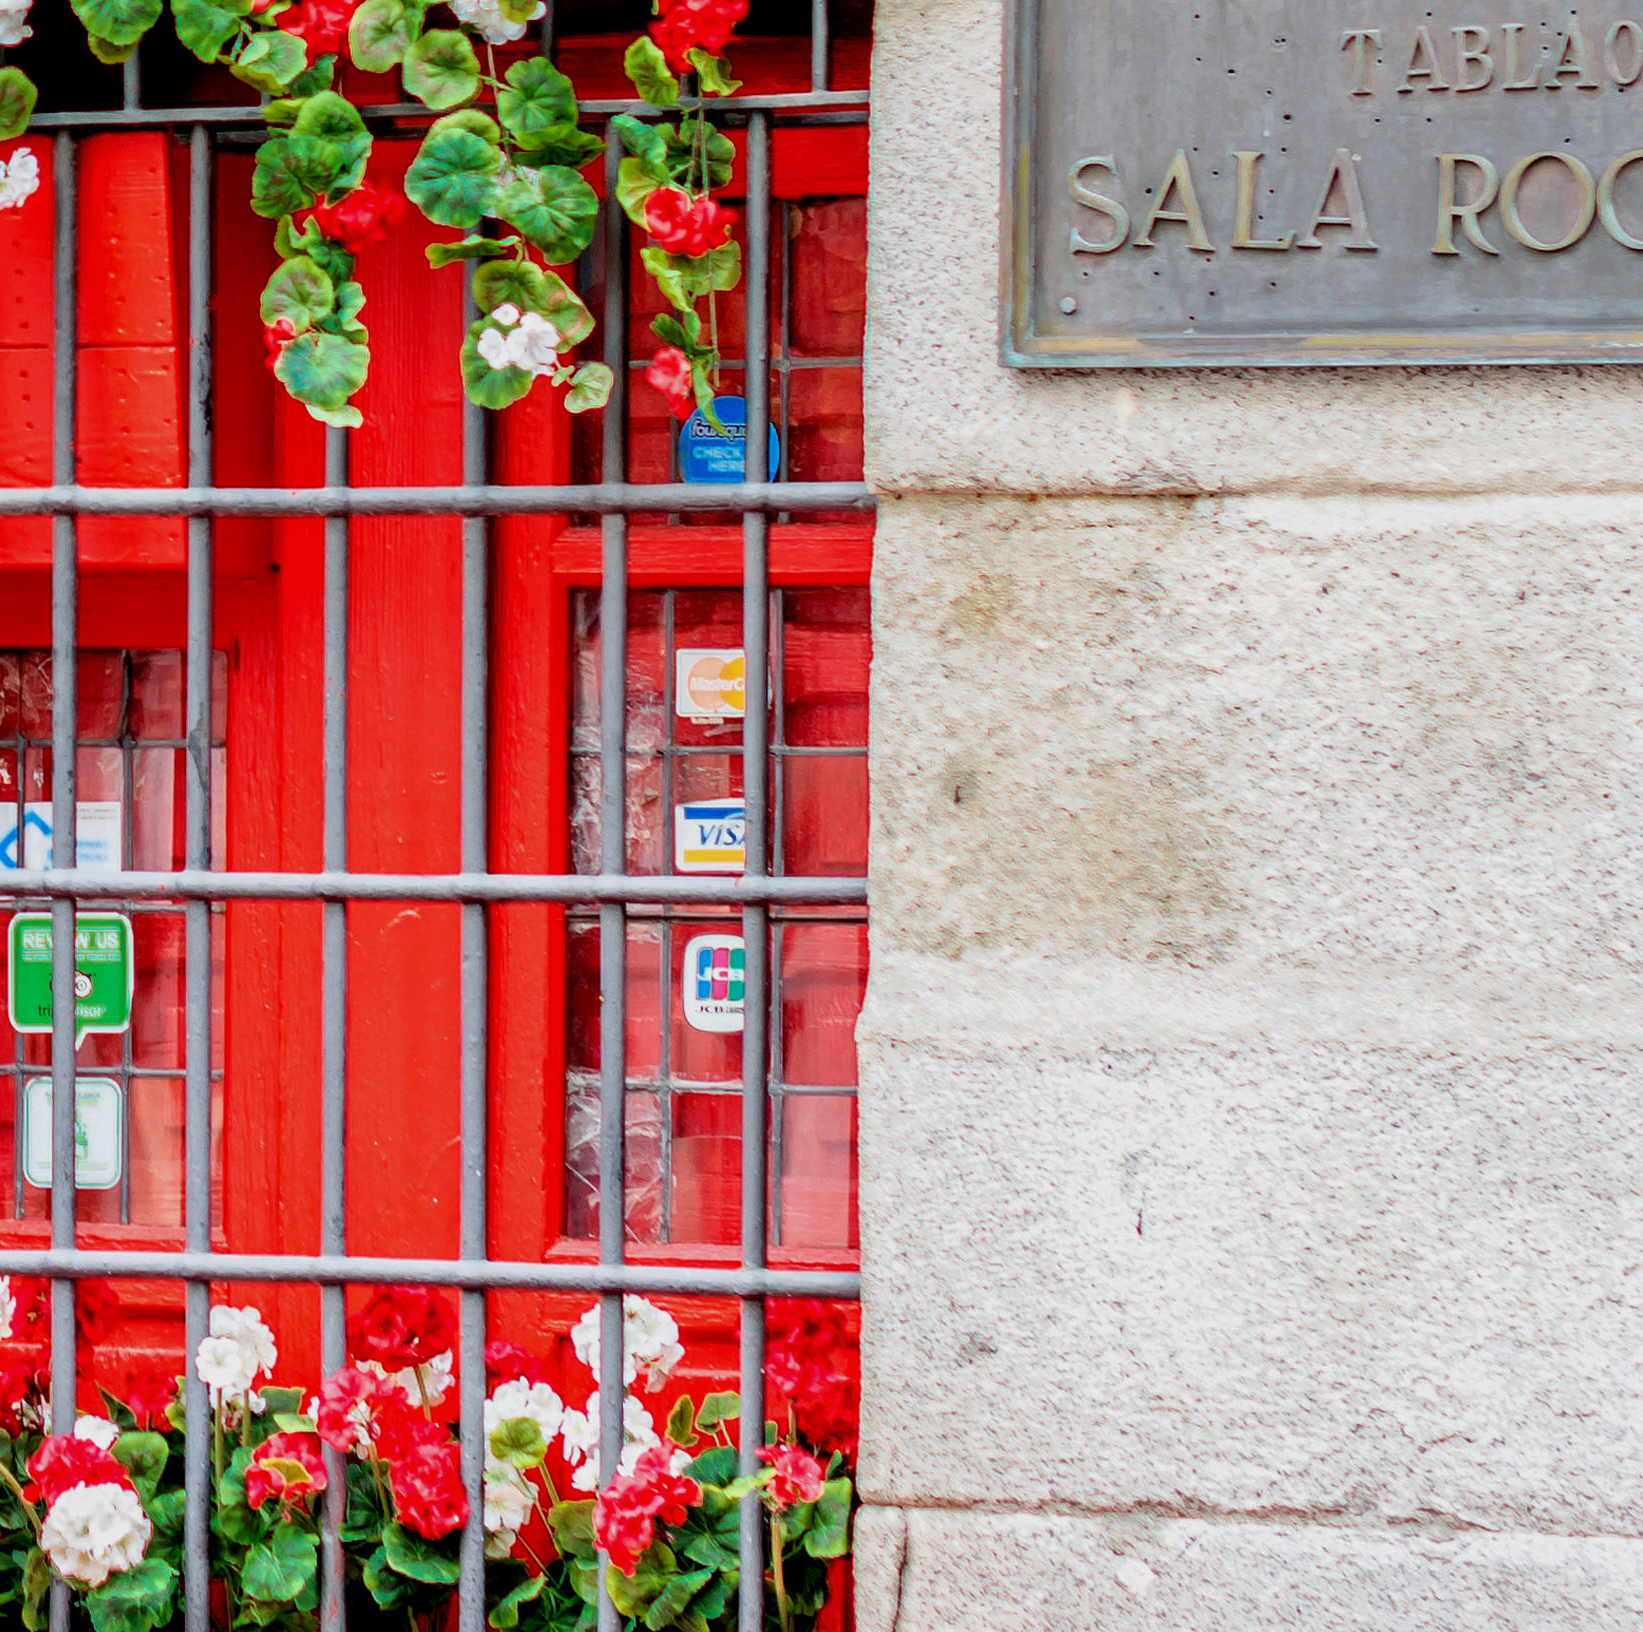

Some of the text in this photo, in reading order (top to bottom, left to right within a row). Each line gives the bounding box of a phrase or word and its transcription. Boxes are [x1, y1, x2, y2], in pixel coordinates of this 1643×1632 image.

[1340, 19, 1643, 96] TABLAO
[1068, 149, 1380, 254] SALA
[690, 678, 745, 692] MasterC
[22, 931, 119, 949] REVW US
[697, 967, 744, 980] JCB
